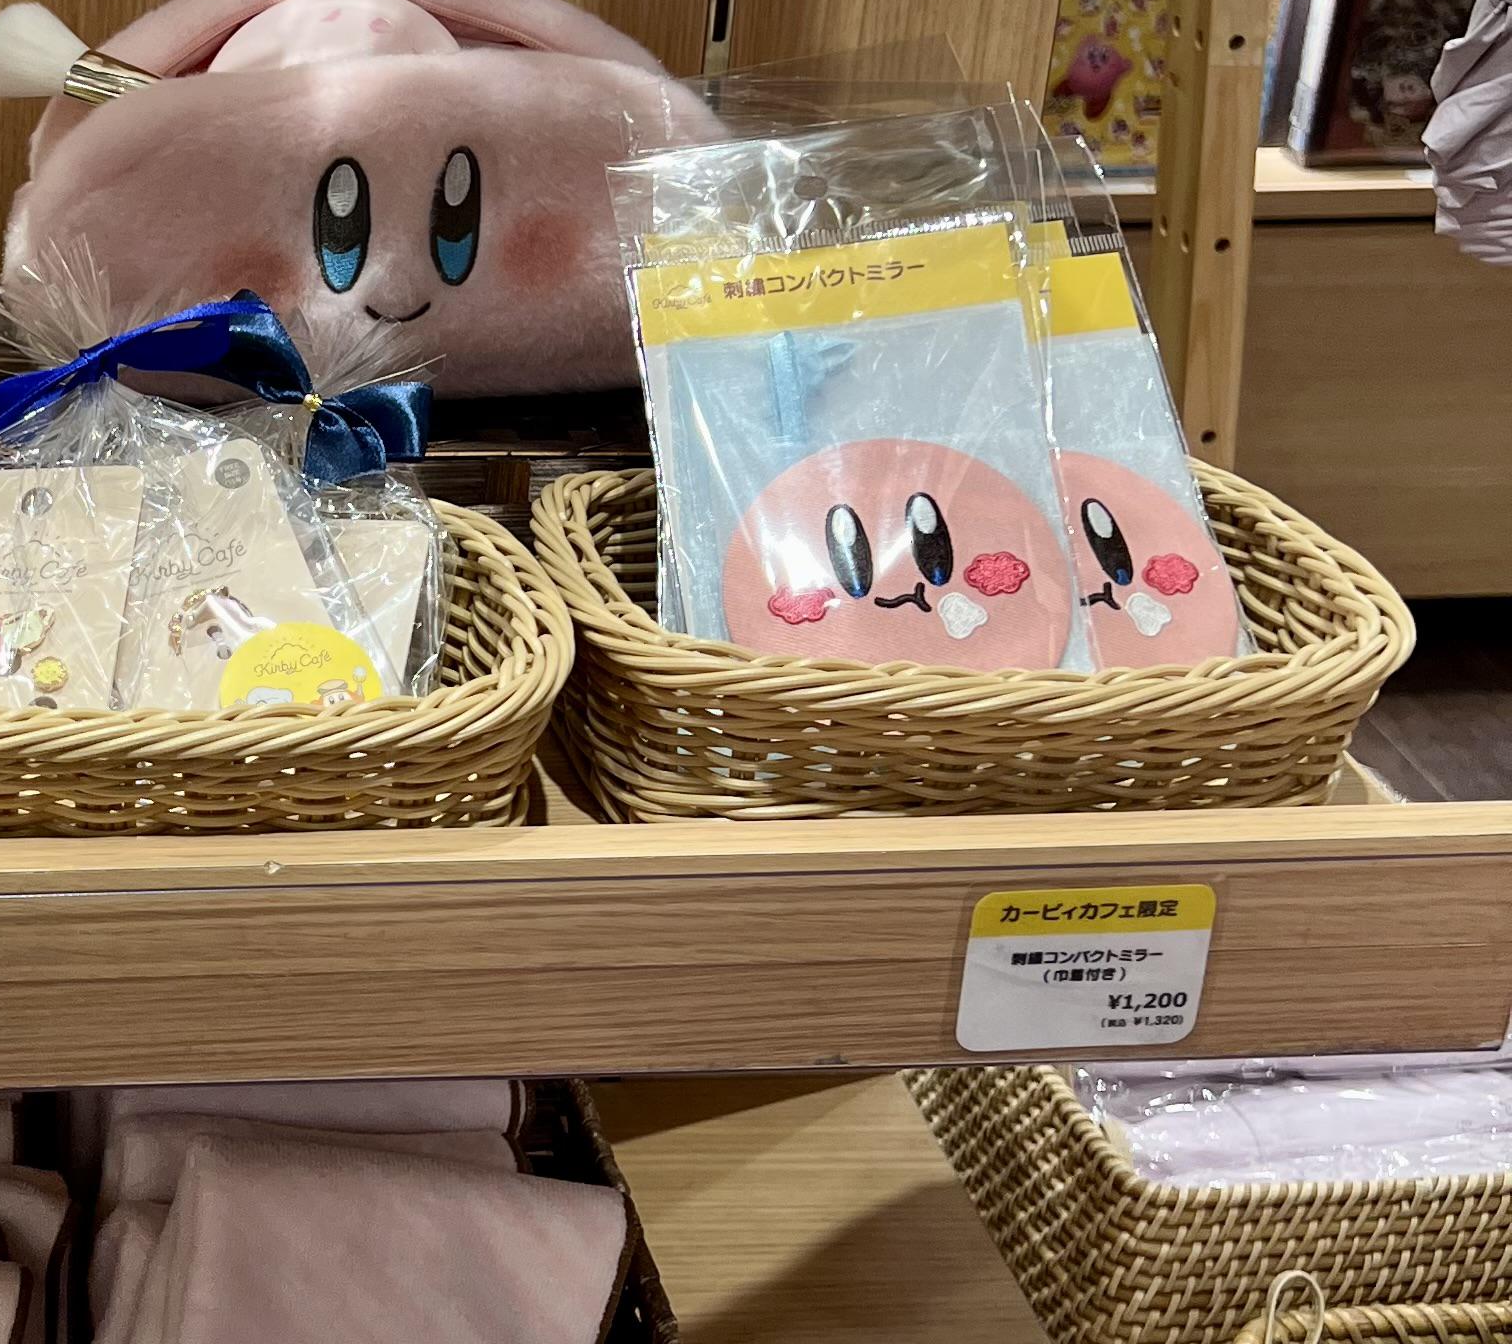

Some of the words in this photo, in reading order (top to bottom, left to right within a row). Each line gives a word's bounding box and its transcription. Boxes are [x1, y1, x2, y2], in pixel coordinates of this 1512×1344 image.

[723, 260, 925, 299] 刺繍コンパクトミラー
[198, 538, 248, 571] Café
[254, 660, 303, 677] Kirby
[300, 649, 332, 668] Café
[1000, 899, 1179, 923] カービィカフェ限定
[1108, 992, 1187, 1012] ¥1,200
